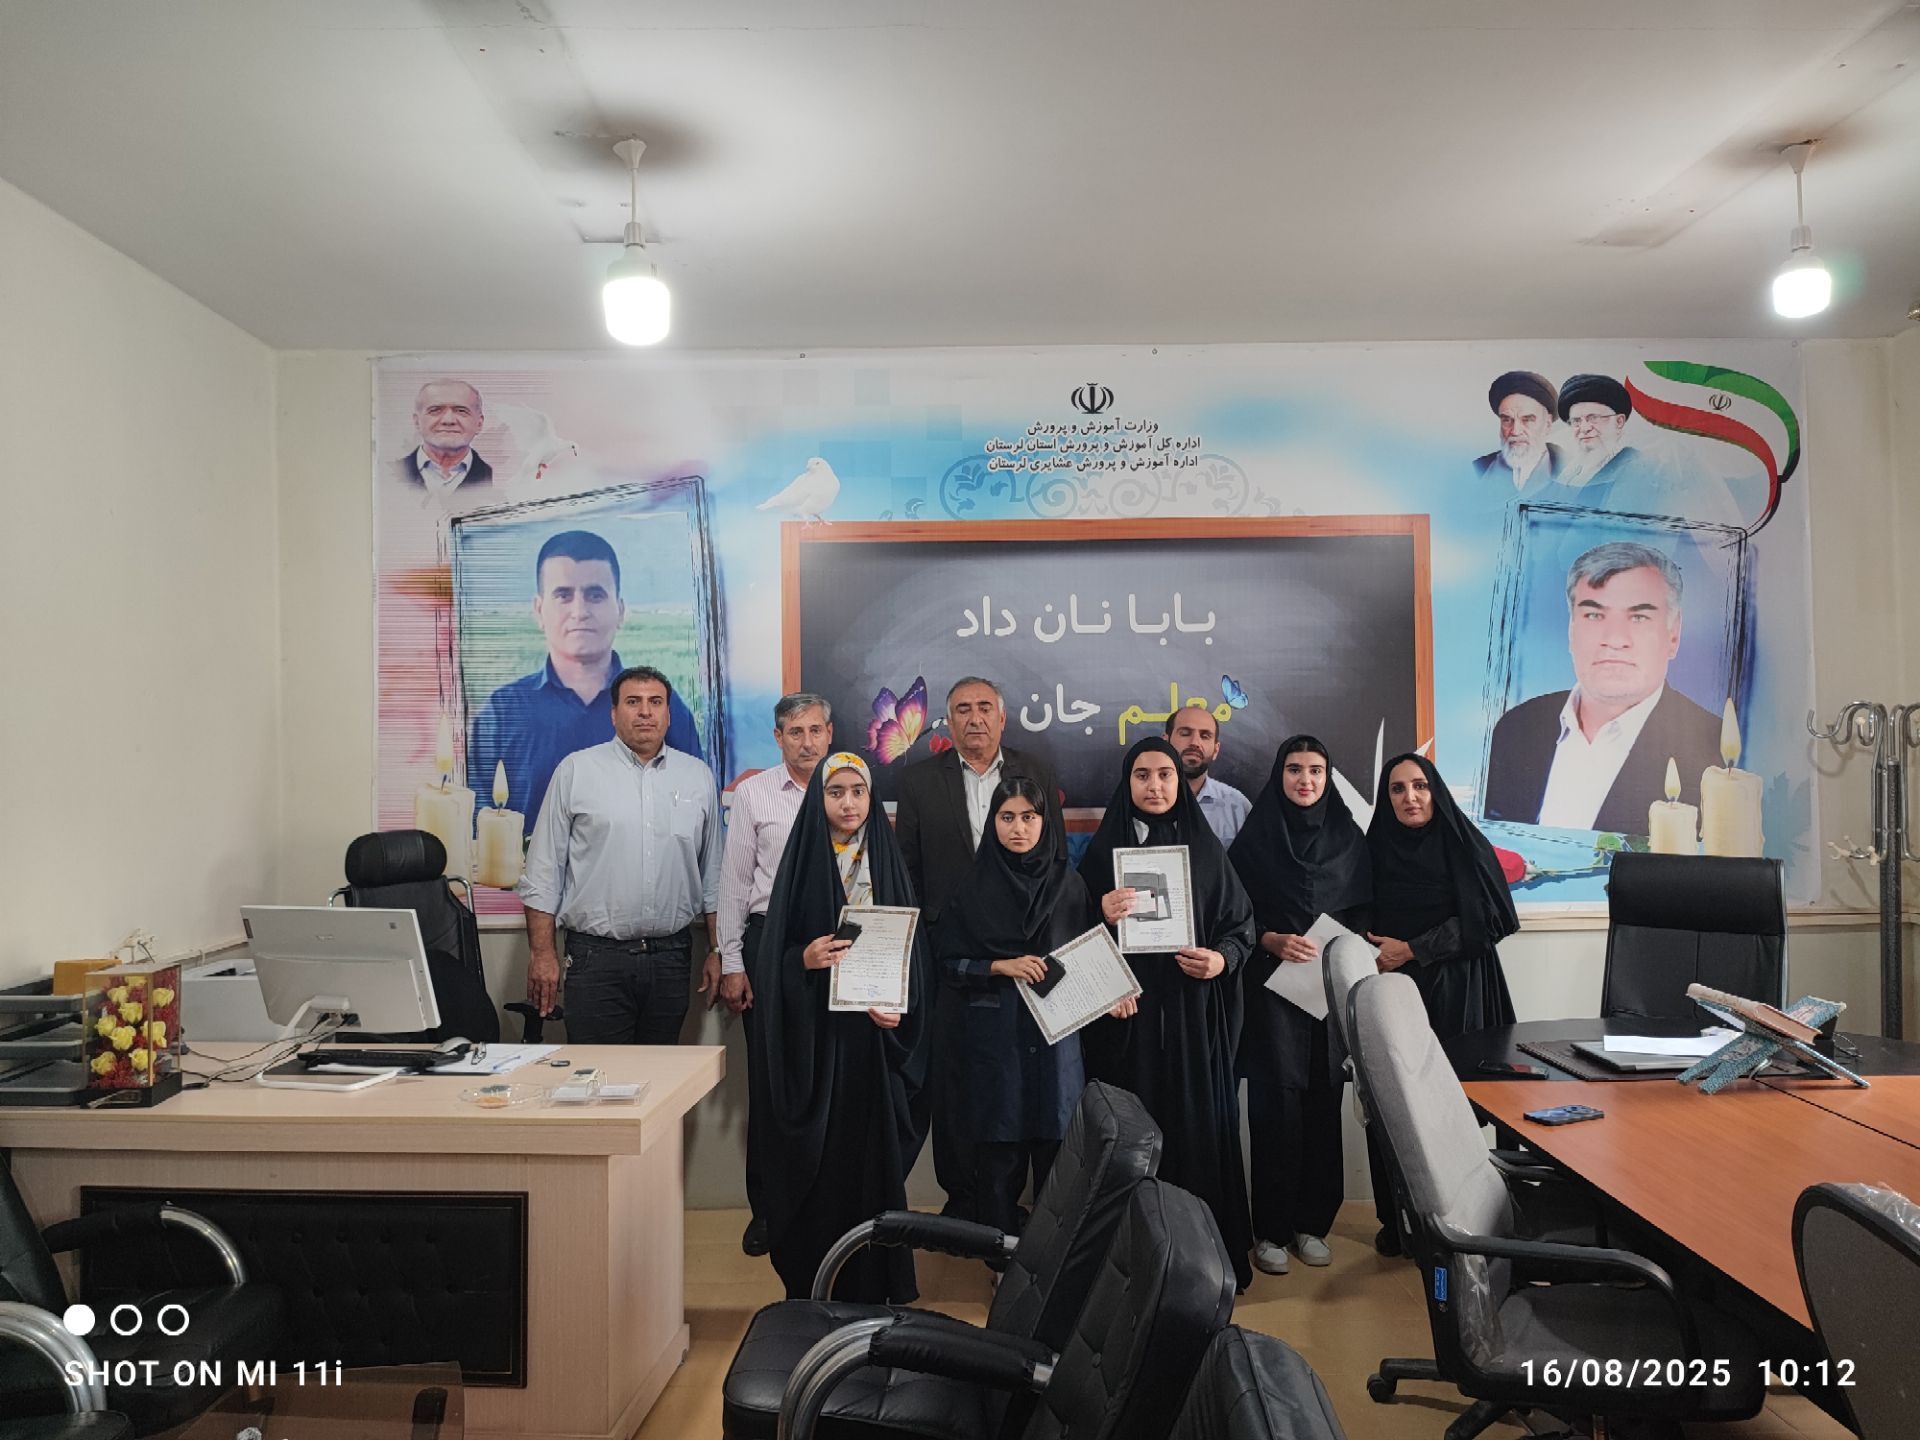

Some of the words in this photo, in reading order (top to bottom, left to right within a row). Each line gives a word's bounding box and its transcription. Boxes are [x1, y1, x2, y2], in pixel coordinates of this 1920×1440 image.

[1027, 421, 1067, 435] پرورش
[1071, 424, 1077, 434] و
[1080, 417, 1120, 435] آموزش
[1124, 419, 1159, 433] وزارت
[986, 438, 1023, 452] لرستان
[1027, 438, 1056, 451] استان
[1060, 440, 1099, 453] پرورش
[1103, 442, 1109, 452] و
[1113, 435, 1153, 452] آموزش
[1156, 437, 1172, 451] کل
[1176, 437, 1200, 450] اداره
[989, 458, 1026, 471] لرستان
[1030, 457, 1073, 471] عشایری
[1077, 458, 1116, 472] پرورش
[1120, 460, 1126, 470] و
[1130, 453, 1169, 471] آموزش
[1173, 456, 1198, 468] اداره
[956, 595, 1017, 638] داد
[1033, 593, 1112, 644] نان
[1128, 592, 1216, 646] بابا
[1019, 683, 1101, 735] جان
